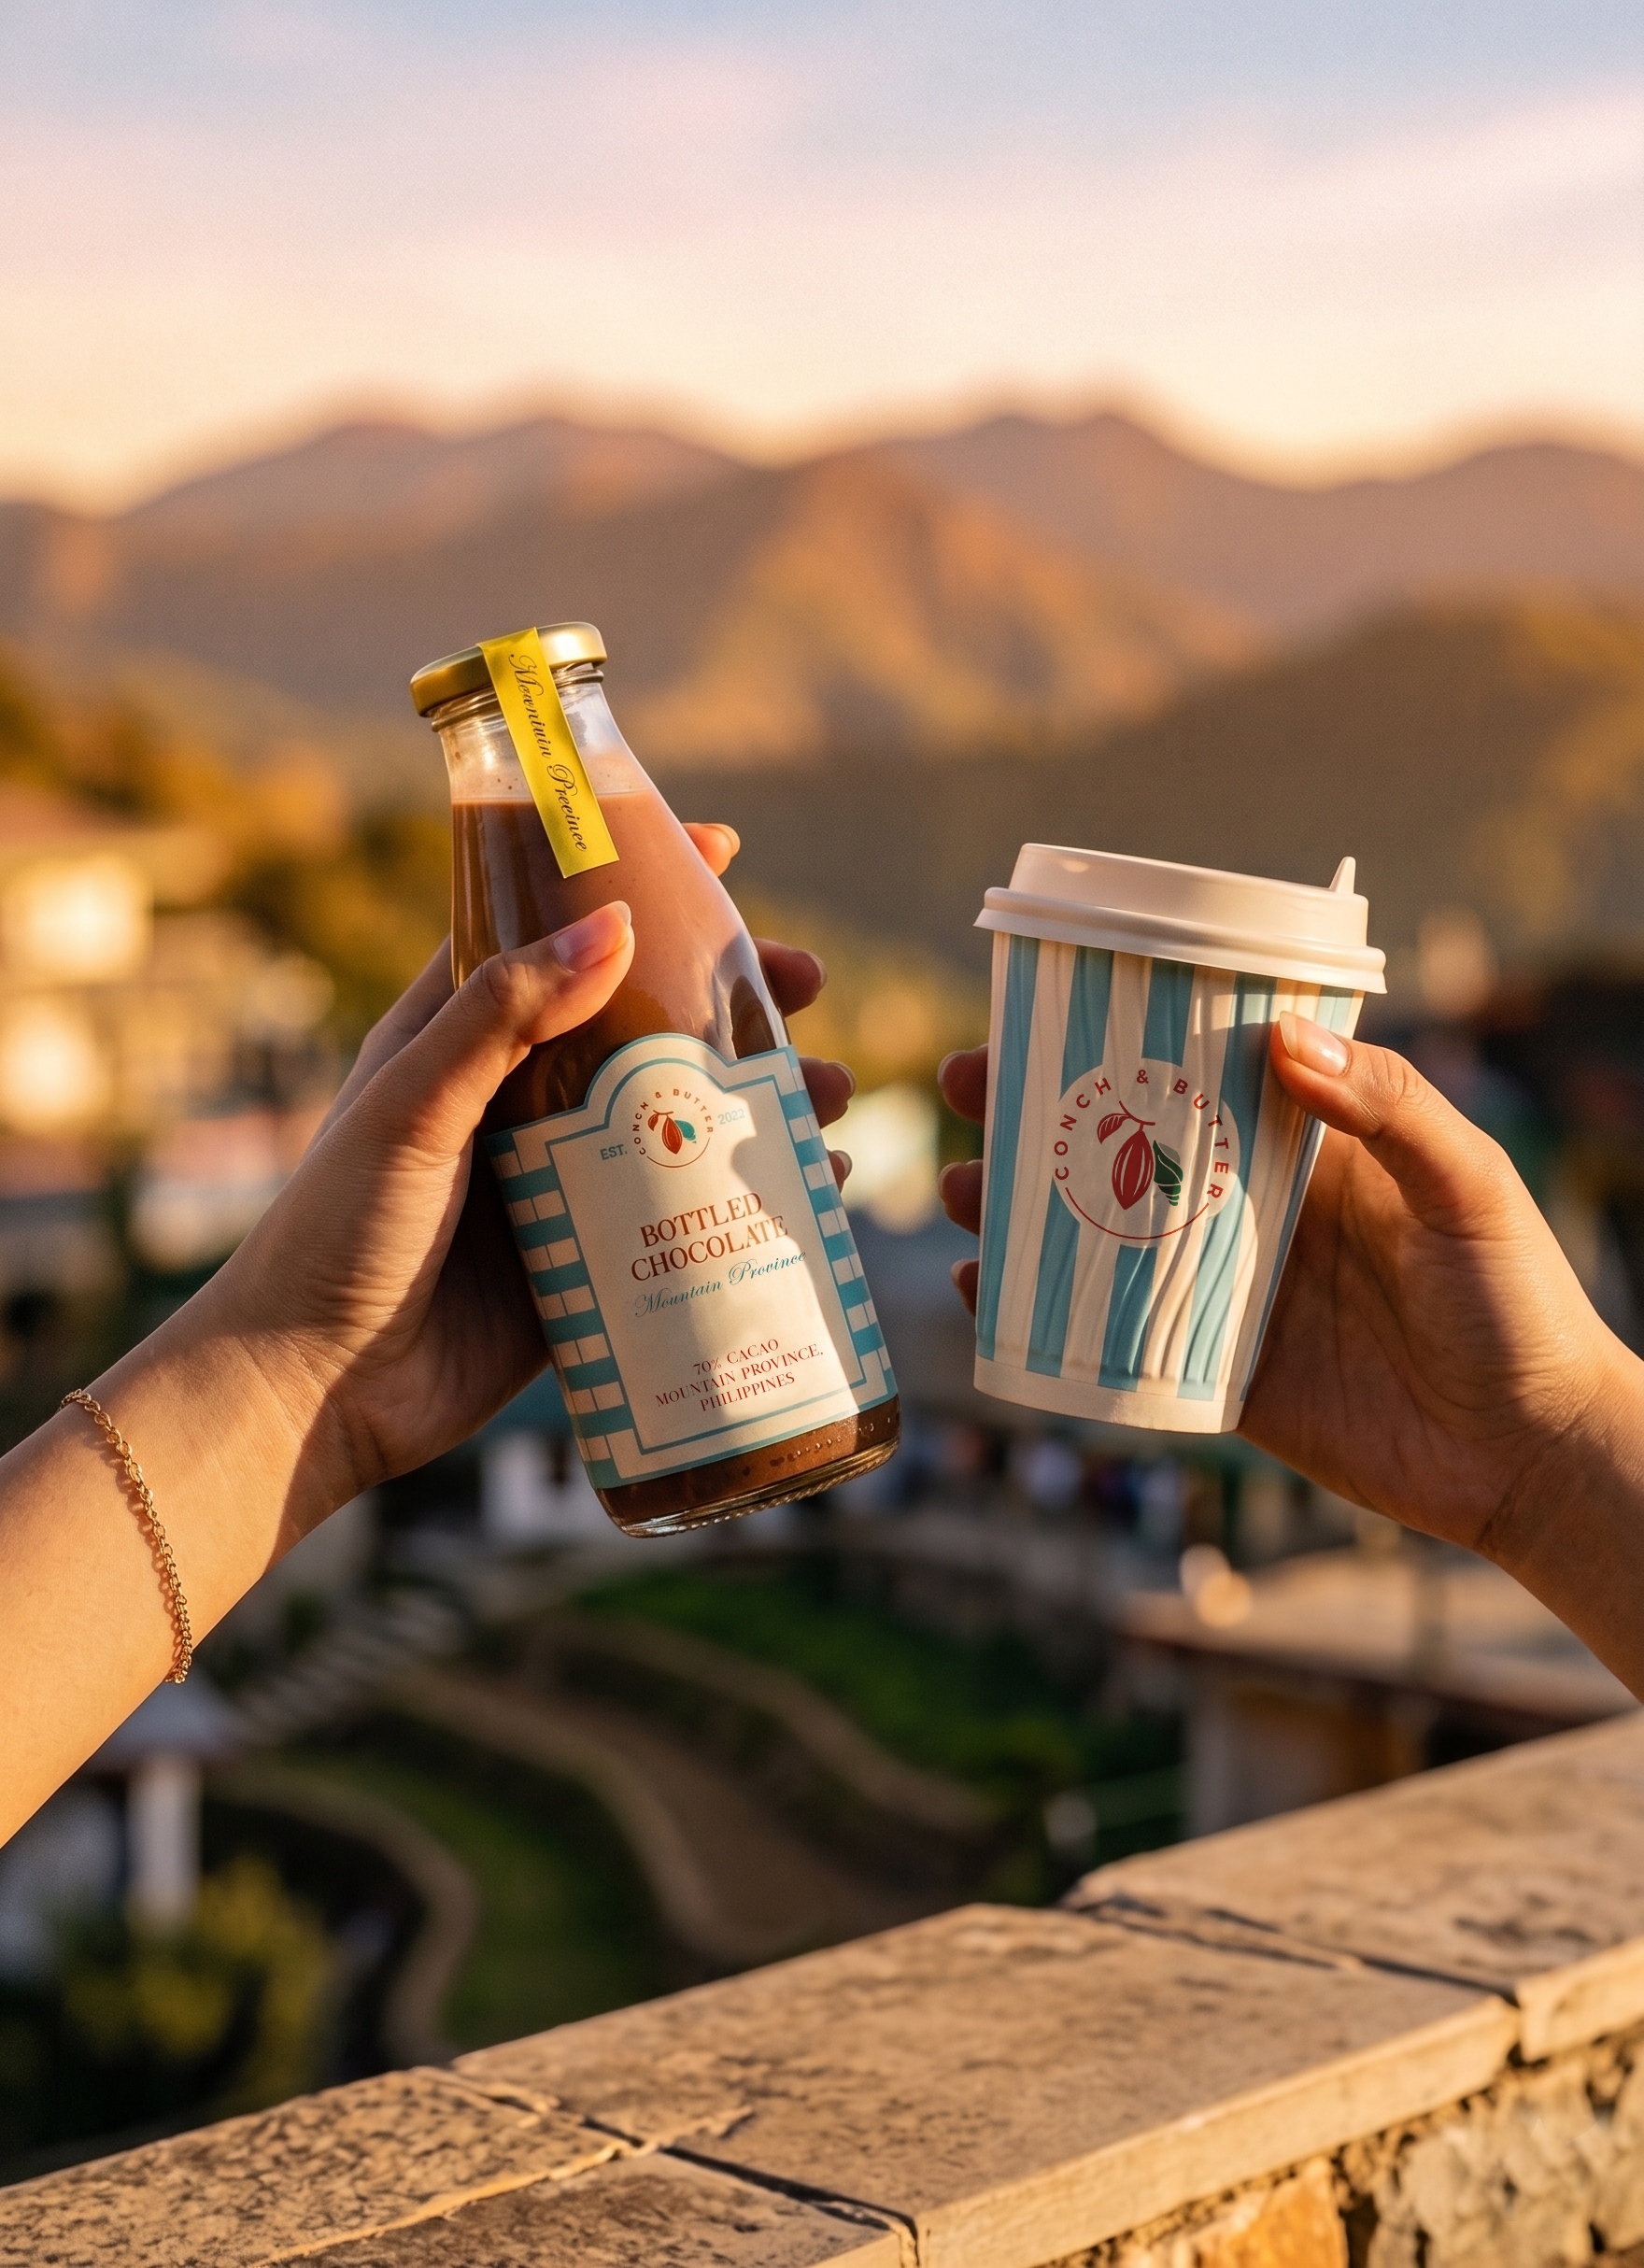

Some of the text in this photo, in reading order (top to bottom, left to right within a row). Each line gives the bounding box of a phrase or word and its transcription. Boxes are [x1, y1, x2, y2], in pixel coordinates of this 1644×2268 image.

[600, 1108, 745, 1160] EST. 2022
[632, 1101, 649, 1155] CONCH
[673, 1088, 714, 1133] BUTTER
[1054, 1069, 1230, 1199] CONCH & BUTTER
[640, 1192, 762, 1248] BOTTLED
[631, 1215, 788, 1282] CHOCOLATE
[634, 1252, 806, 1318] Mountain Province
[692, 1339, 779, 1376] 70% CACAO
[655, 1370, 736, 1408] MOUNTAIN
[700, 1371, 795, 1411] PHILIPPINES
